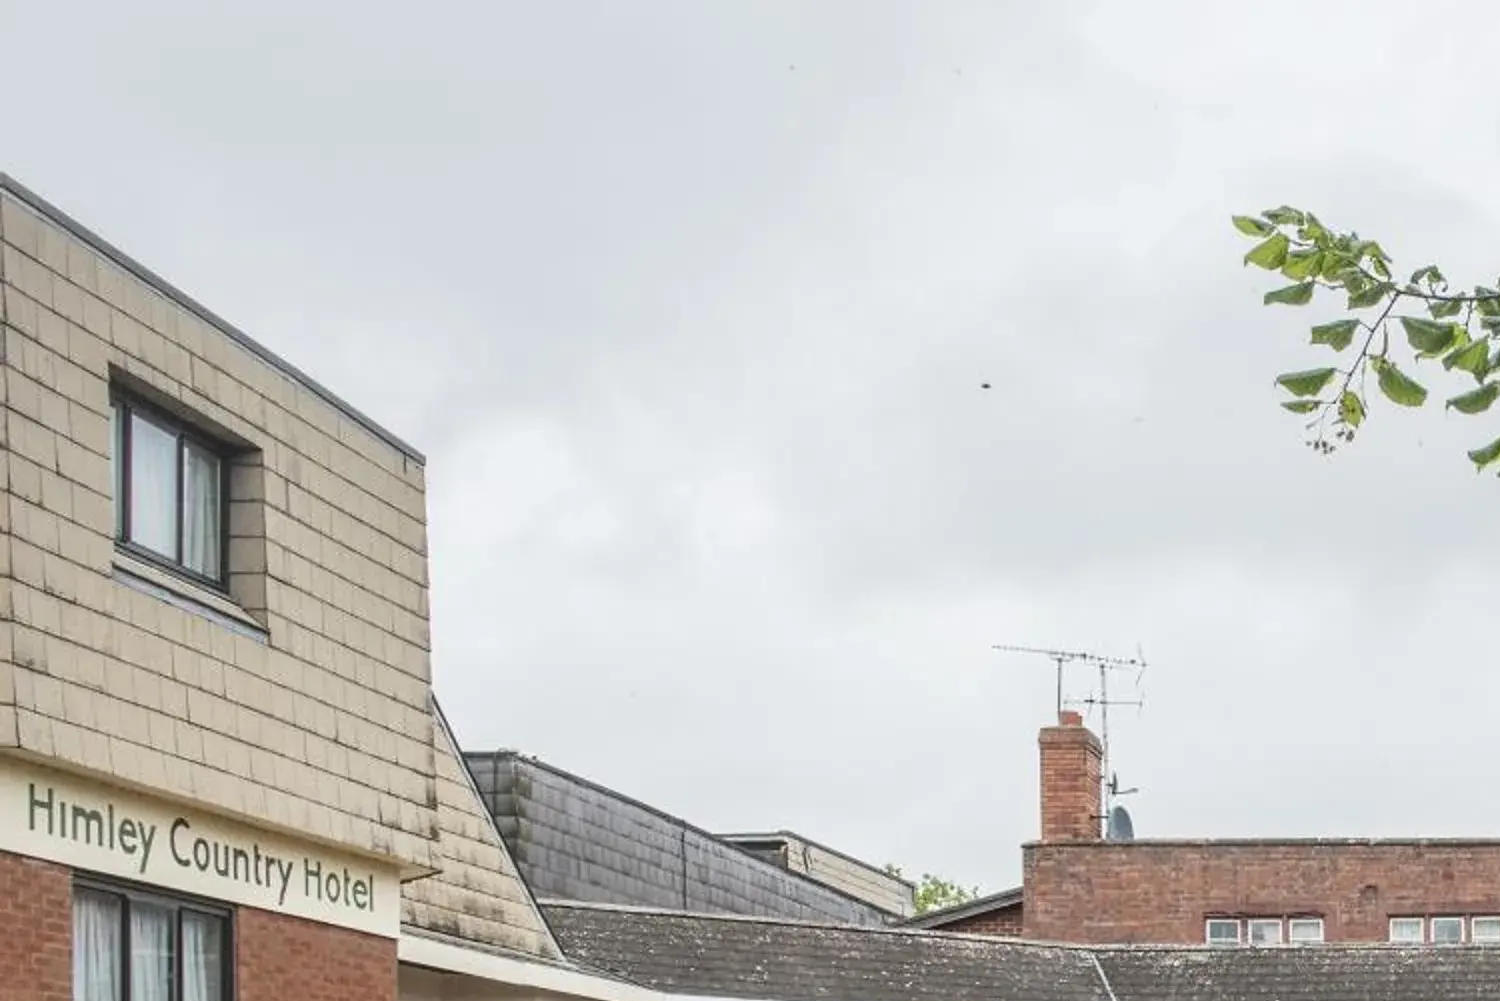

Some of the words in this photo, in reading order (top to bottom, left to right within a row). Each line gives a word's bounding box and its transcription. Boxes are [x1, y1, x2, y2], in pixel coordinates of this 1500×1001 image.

[29, 783, 157, 874] Himley
[169, 817, 294, 906] Country
[304, 857, 375, 912] Hotel
